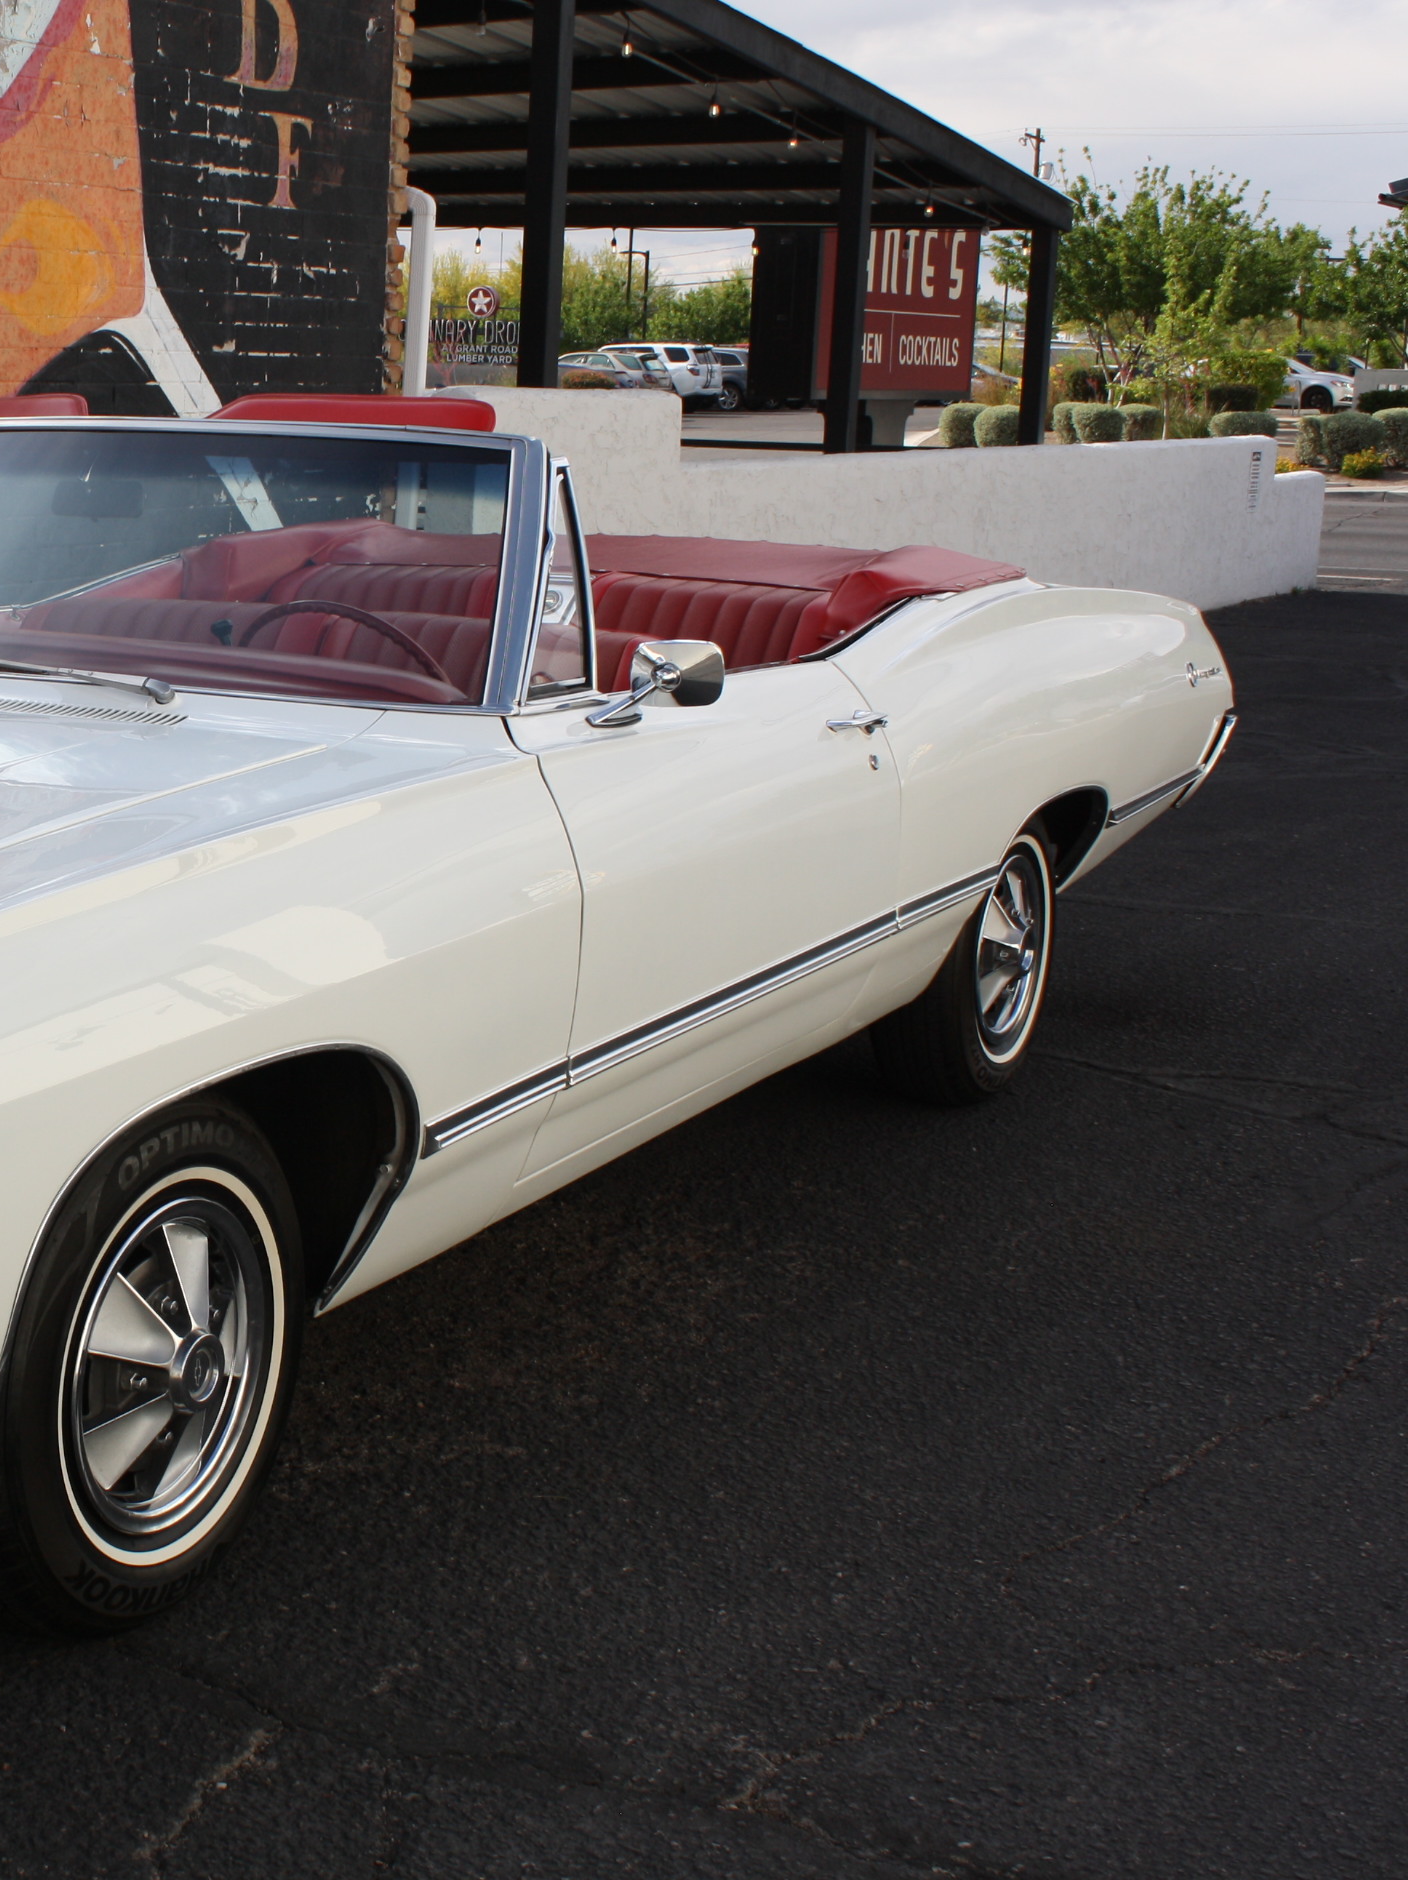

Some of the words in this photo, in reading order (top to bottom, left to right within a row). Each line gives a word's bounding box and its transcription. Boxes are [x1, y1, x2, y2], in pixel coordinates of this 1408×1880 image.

[224, 0, 299, 92] D
[260, 111, 314, 210] F
[446, 353, 484, 363] LUMBER
[487, 354, 513, 364] YARD
[455, 345, 488, 354] GRANT
[490, 345, 518, 354] ROAD
[898, 335, 960, 367] COCKTAILS
[118, 1120, 235, 1191] OPTIMO
